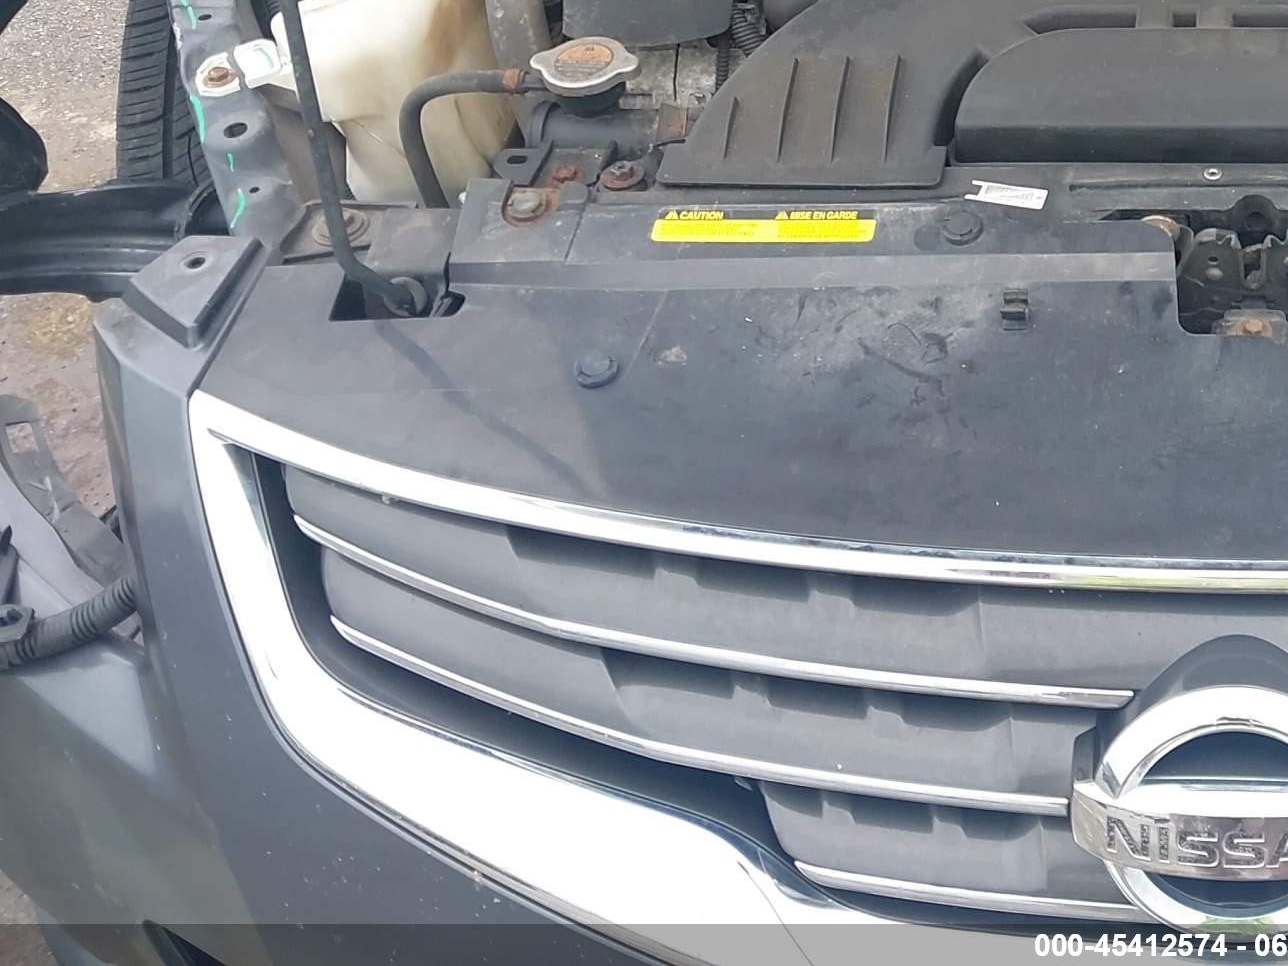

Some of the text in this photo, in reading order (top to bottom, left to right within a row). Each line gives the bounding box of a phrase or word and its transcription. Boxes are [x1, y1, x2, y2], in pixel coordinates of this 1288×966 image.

[680, 210, 725, 220] CAUTION
[789, 210, 859, 220] MISE EN GARDE
